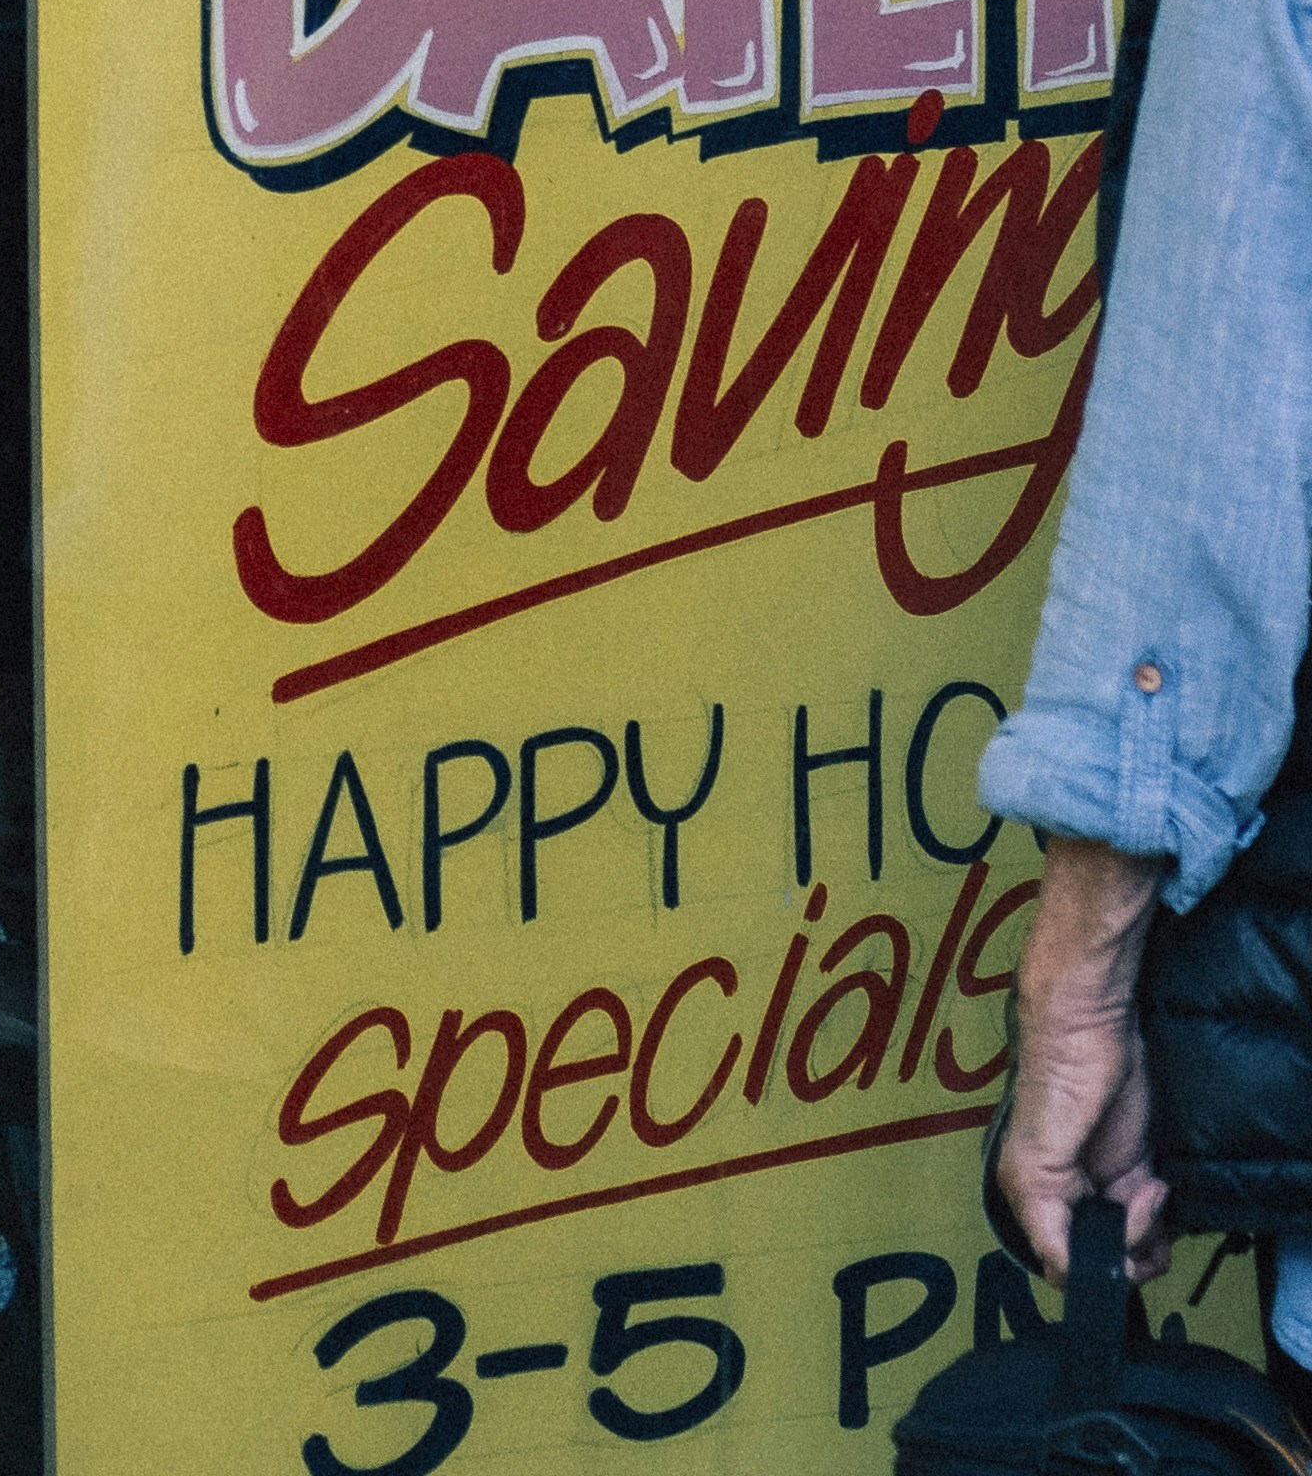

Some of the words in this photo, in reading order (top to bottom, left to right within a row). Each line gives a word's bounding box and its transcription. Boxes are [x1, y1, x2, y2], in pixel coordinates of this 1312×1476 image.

[179, 701, 725, 956] HAPPY
[794, 680, 1048, 888] HO
[269, 860, 1042, 1246] specials
[300, 1260, 748, 1476] 3-5
